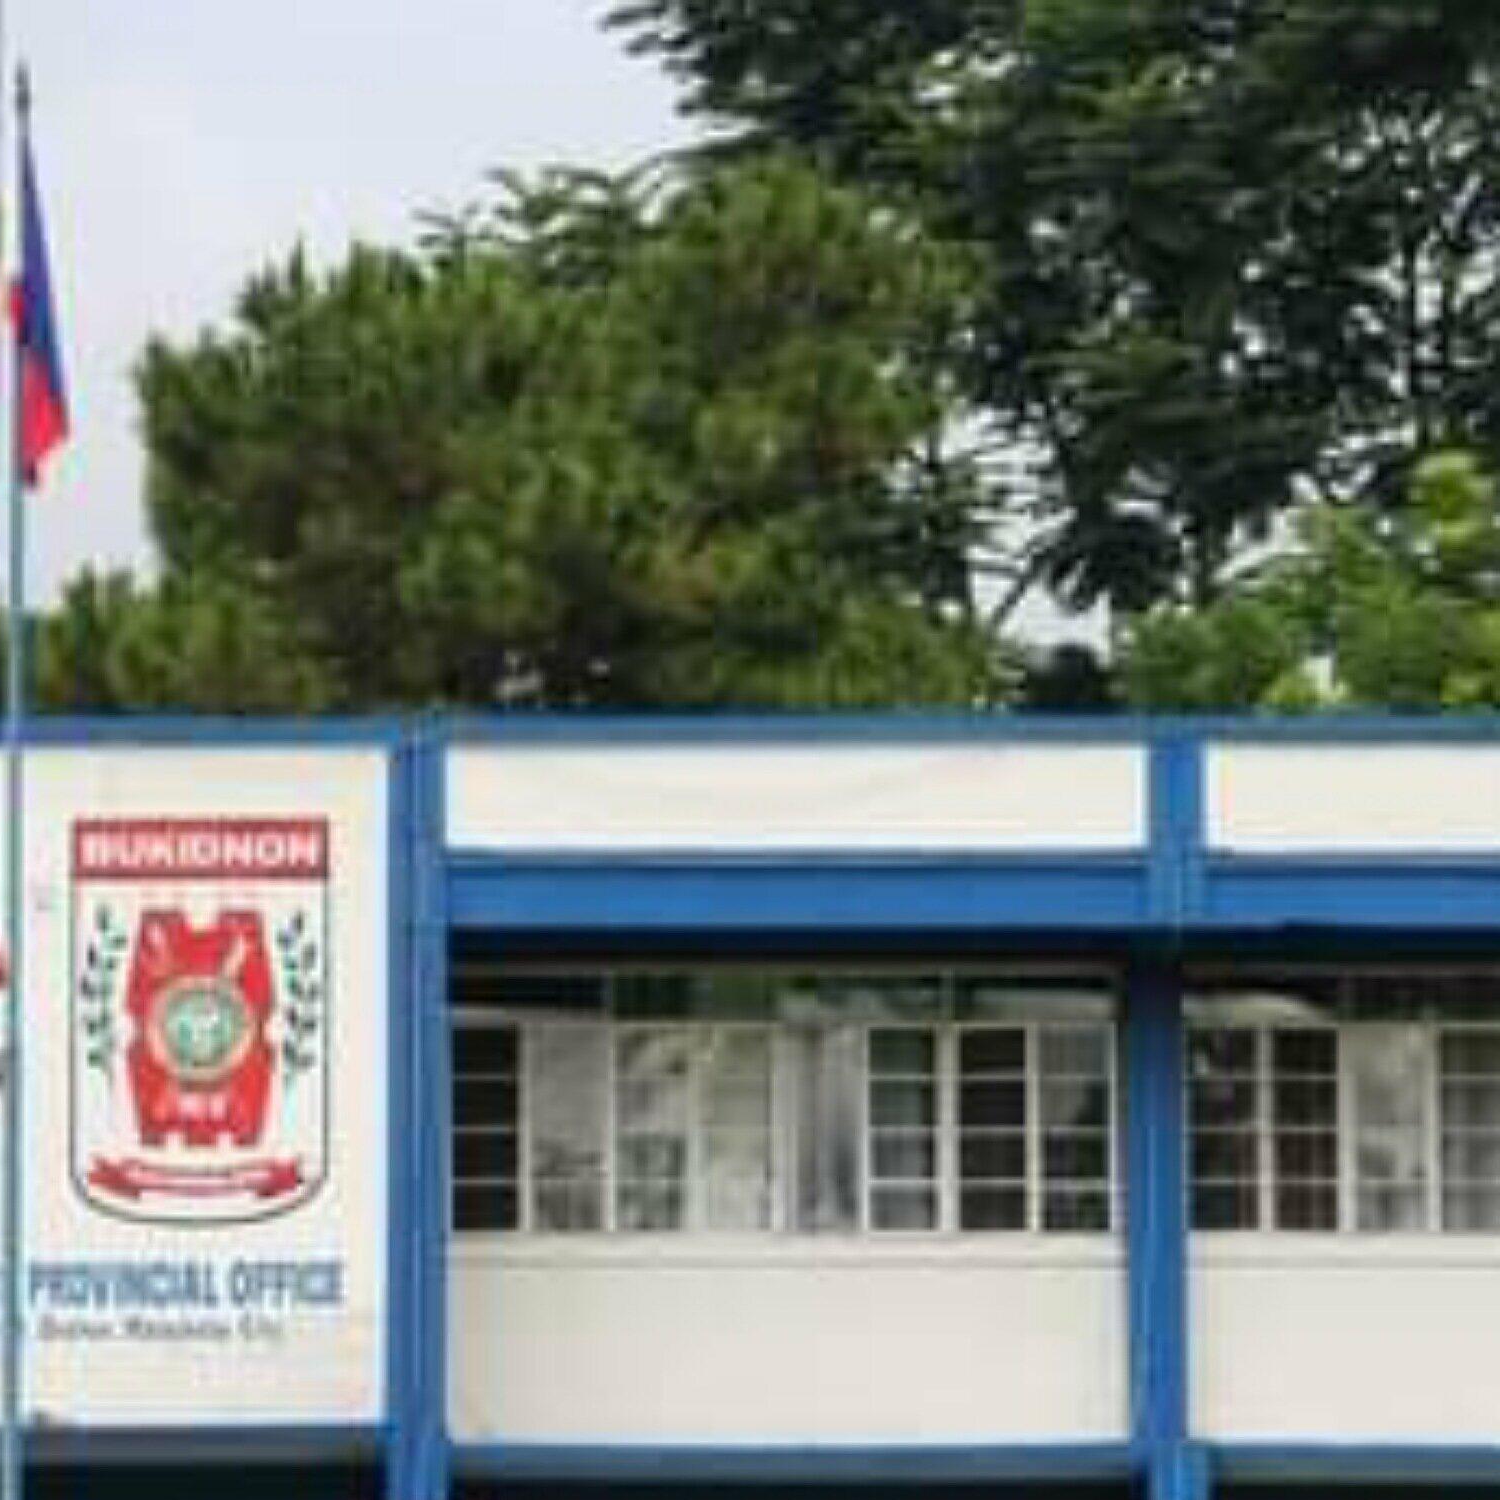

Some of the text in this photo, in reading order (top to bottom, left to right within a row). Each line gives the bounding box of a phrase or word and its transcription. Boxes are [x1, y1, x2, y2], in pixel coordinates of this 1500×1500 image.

[81, 830, 318, 867] BUKIDNON
[31, 1260, 219, 1307] PROVINCIAL
[229, 1260, 342, 1307] OFFICE
